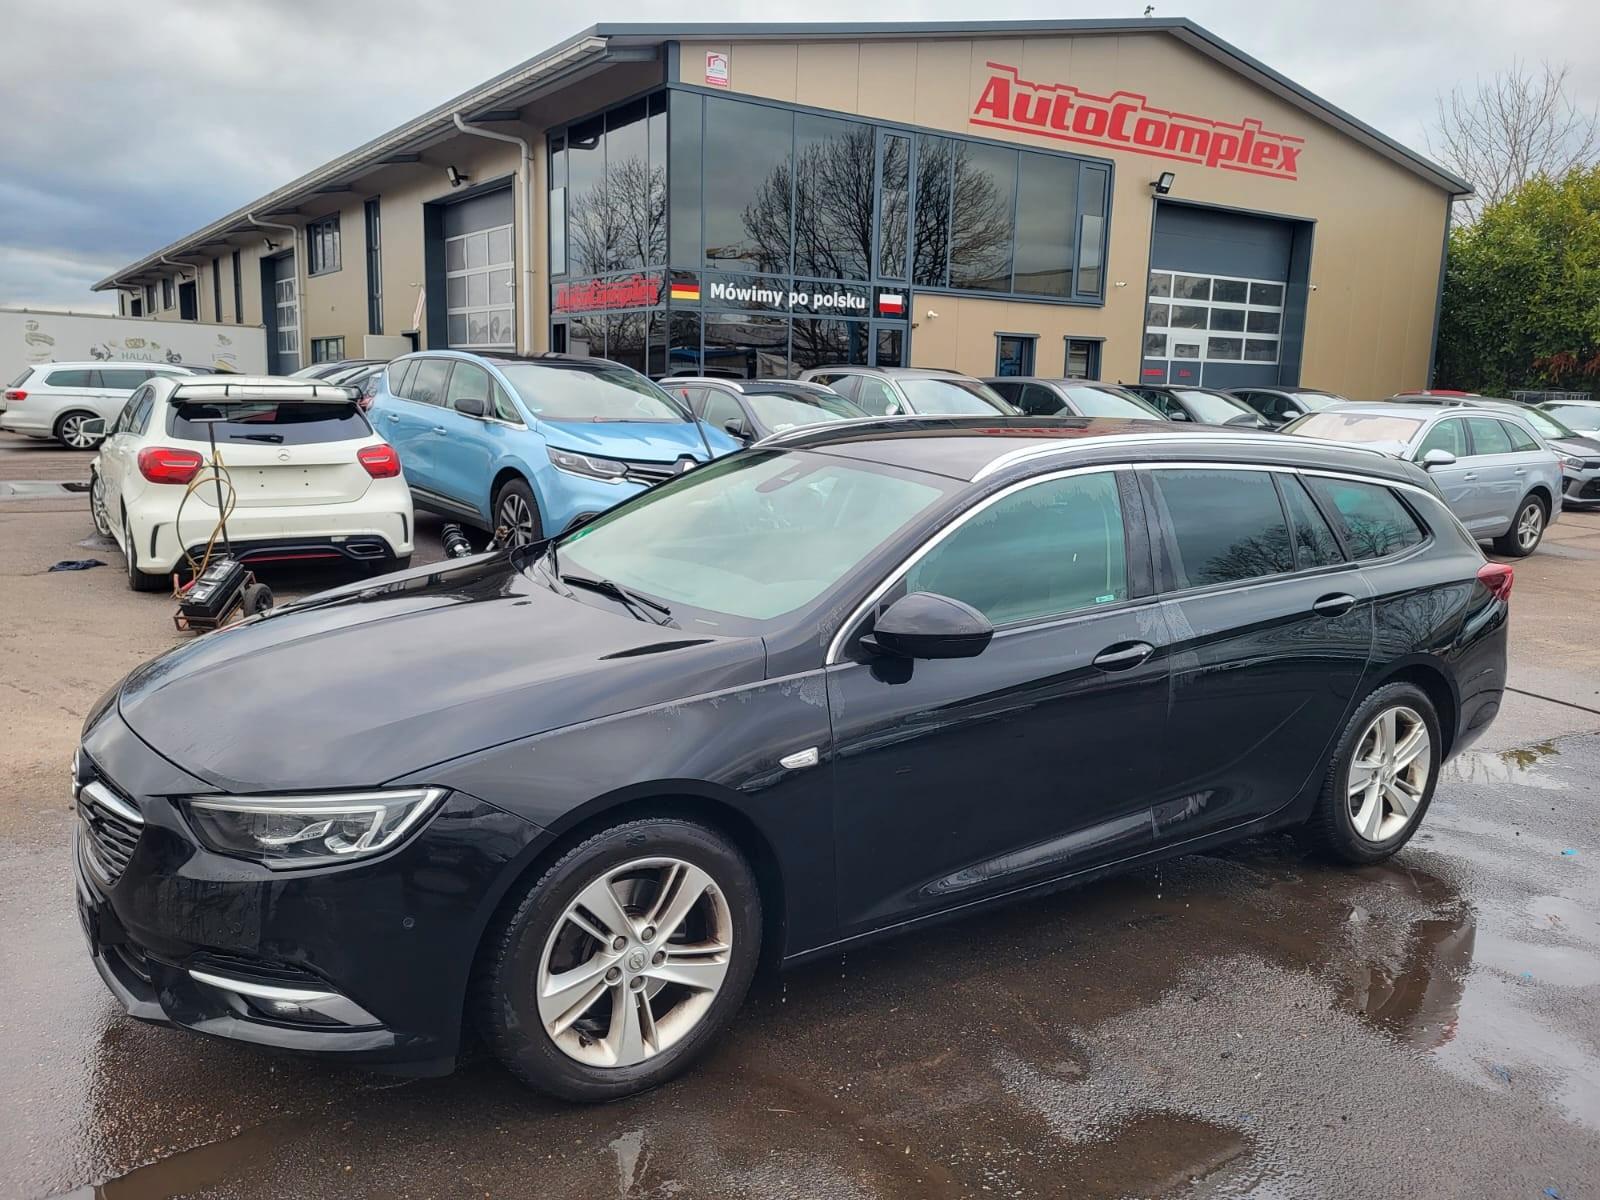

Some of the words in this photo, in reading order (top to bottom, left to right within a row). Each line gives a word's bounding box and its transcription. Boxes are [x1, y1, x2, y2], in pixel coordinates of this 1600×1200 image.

[974, 76, 1302, 172] AutoComplex
[710, 282, 783, 307] Mówimy
[789, 292, 808, 308] po
[813, 292, 866, 310] polsku
[121, 352, 153, 361] HALAL
